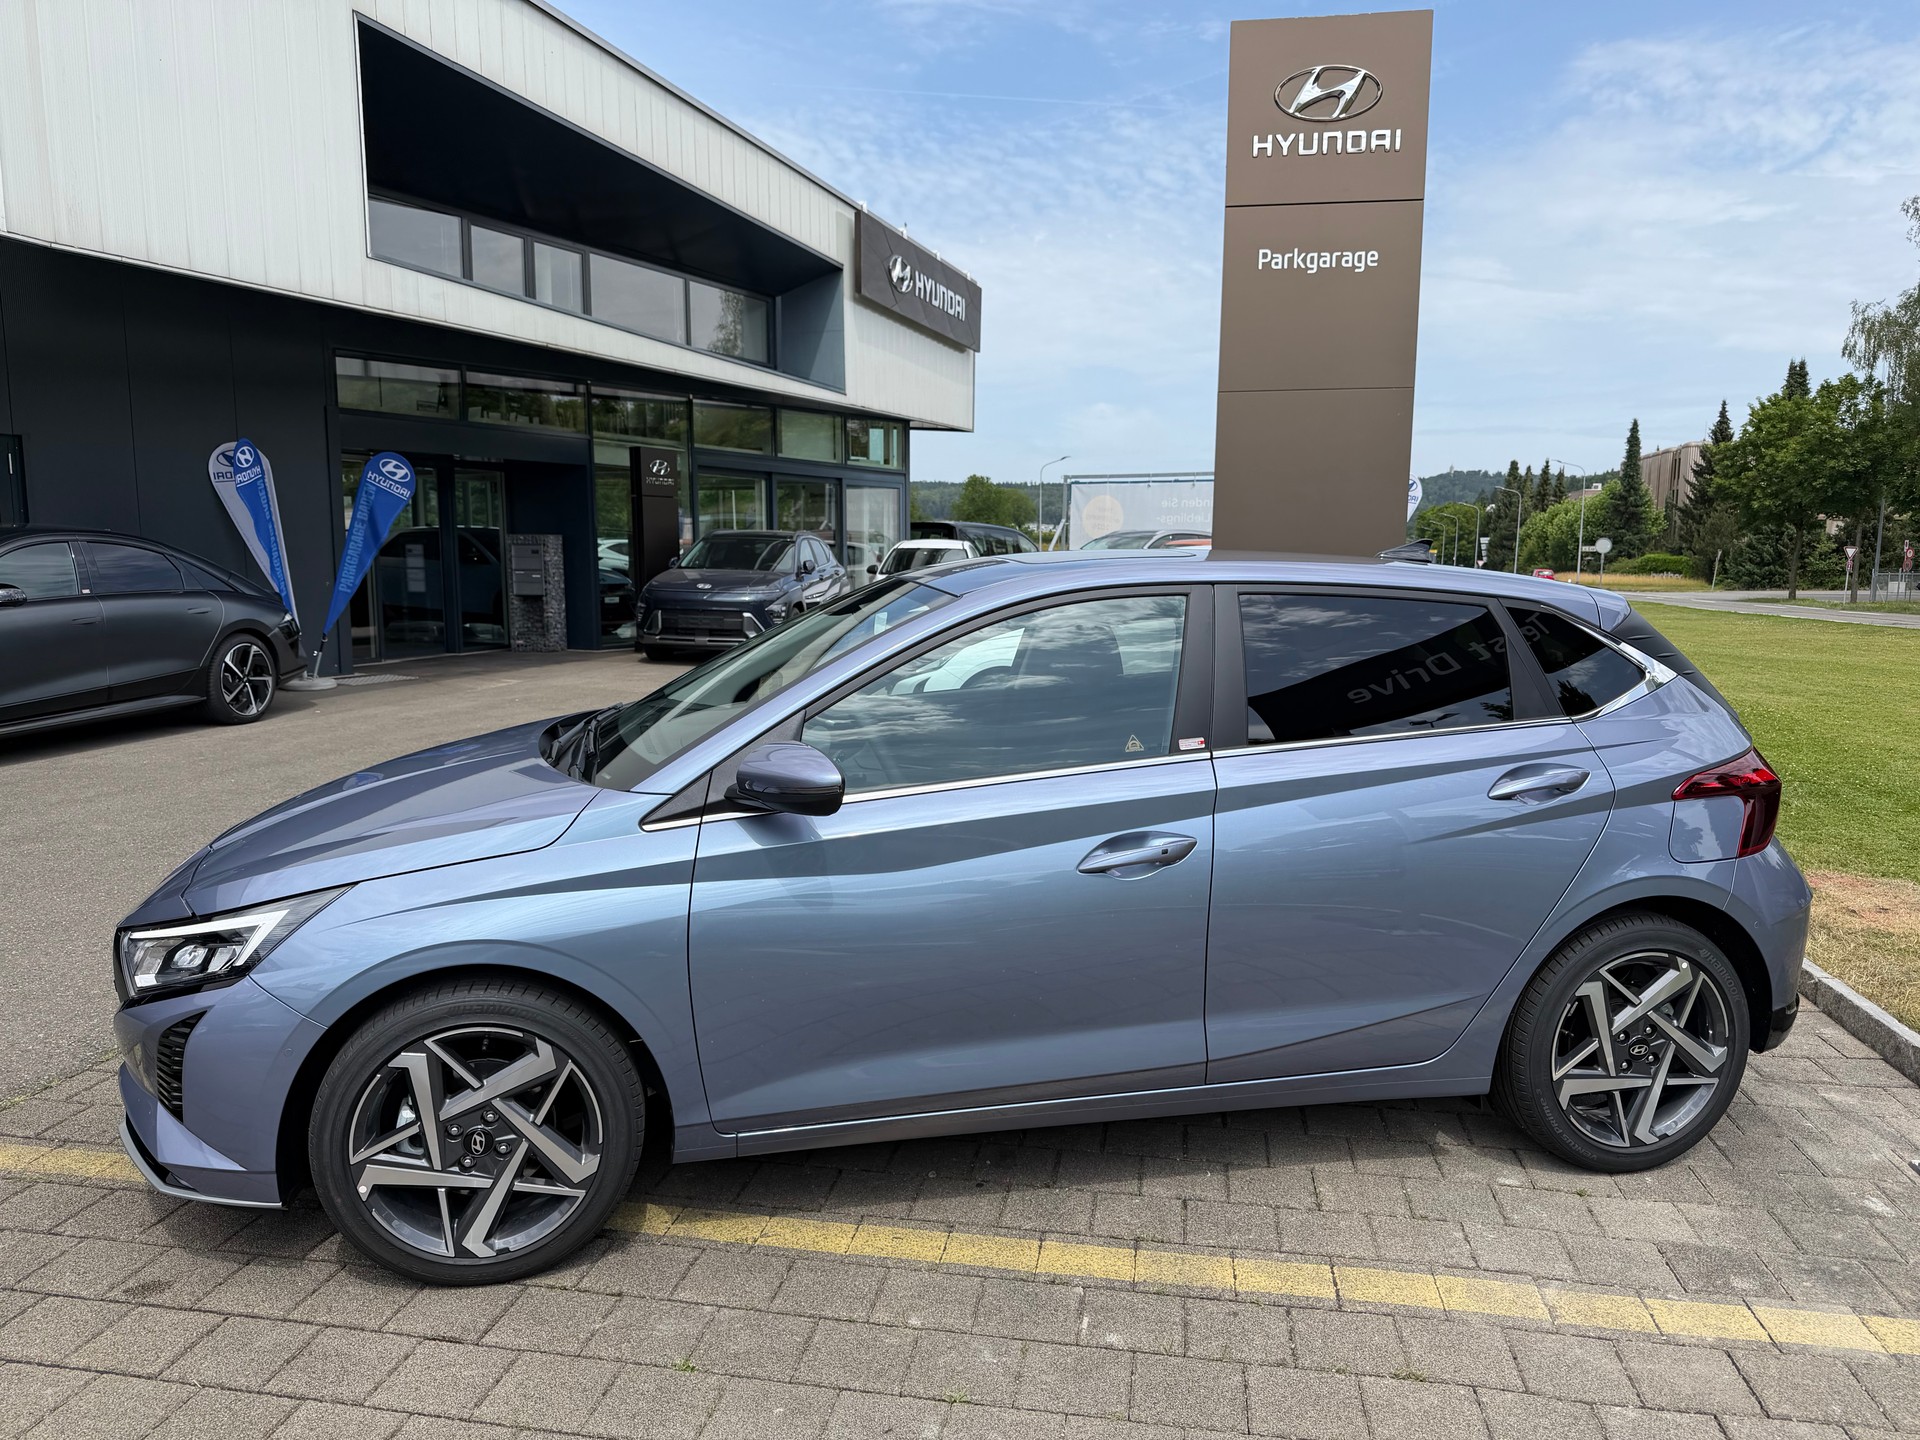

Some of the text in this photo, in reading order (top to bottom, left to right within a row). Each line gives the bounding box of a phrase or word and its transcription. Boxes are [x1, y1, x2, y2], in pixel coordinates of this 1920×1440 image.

[1252, 128, 1401, 158] HYUNDAI
[1258, 248, 1379, 274] Parkgarage
[915, 270, 966, 321] HYUNDAI
[367, 470, 411, 499] HYUNDAI
[338, 483, 377, 593] PARKGARAGE BADEN
